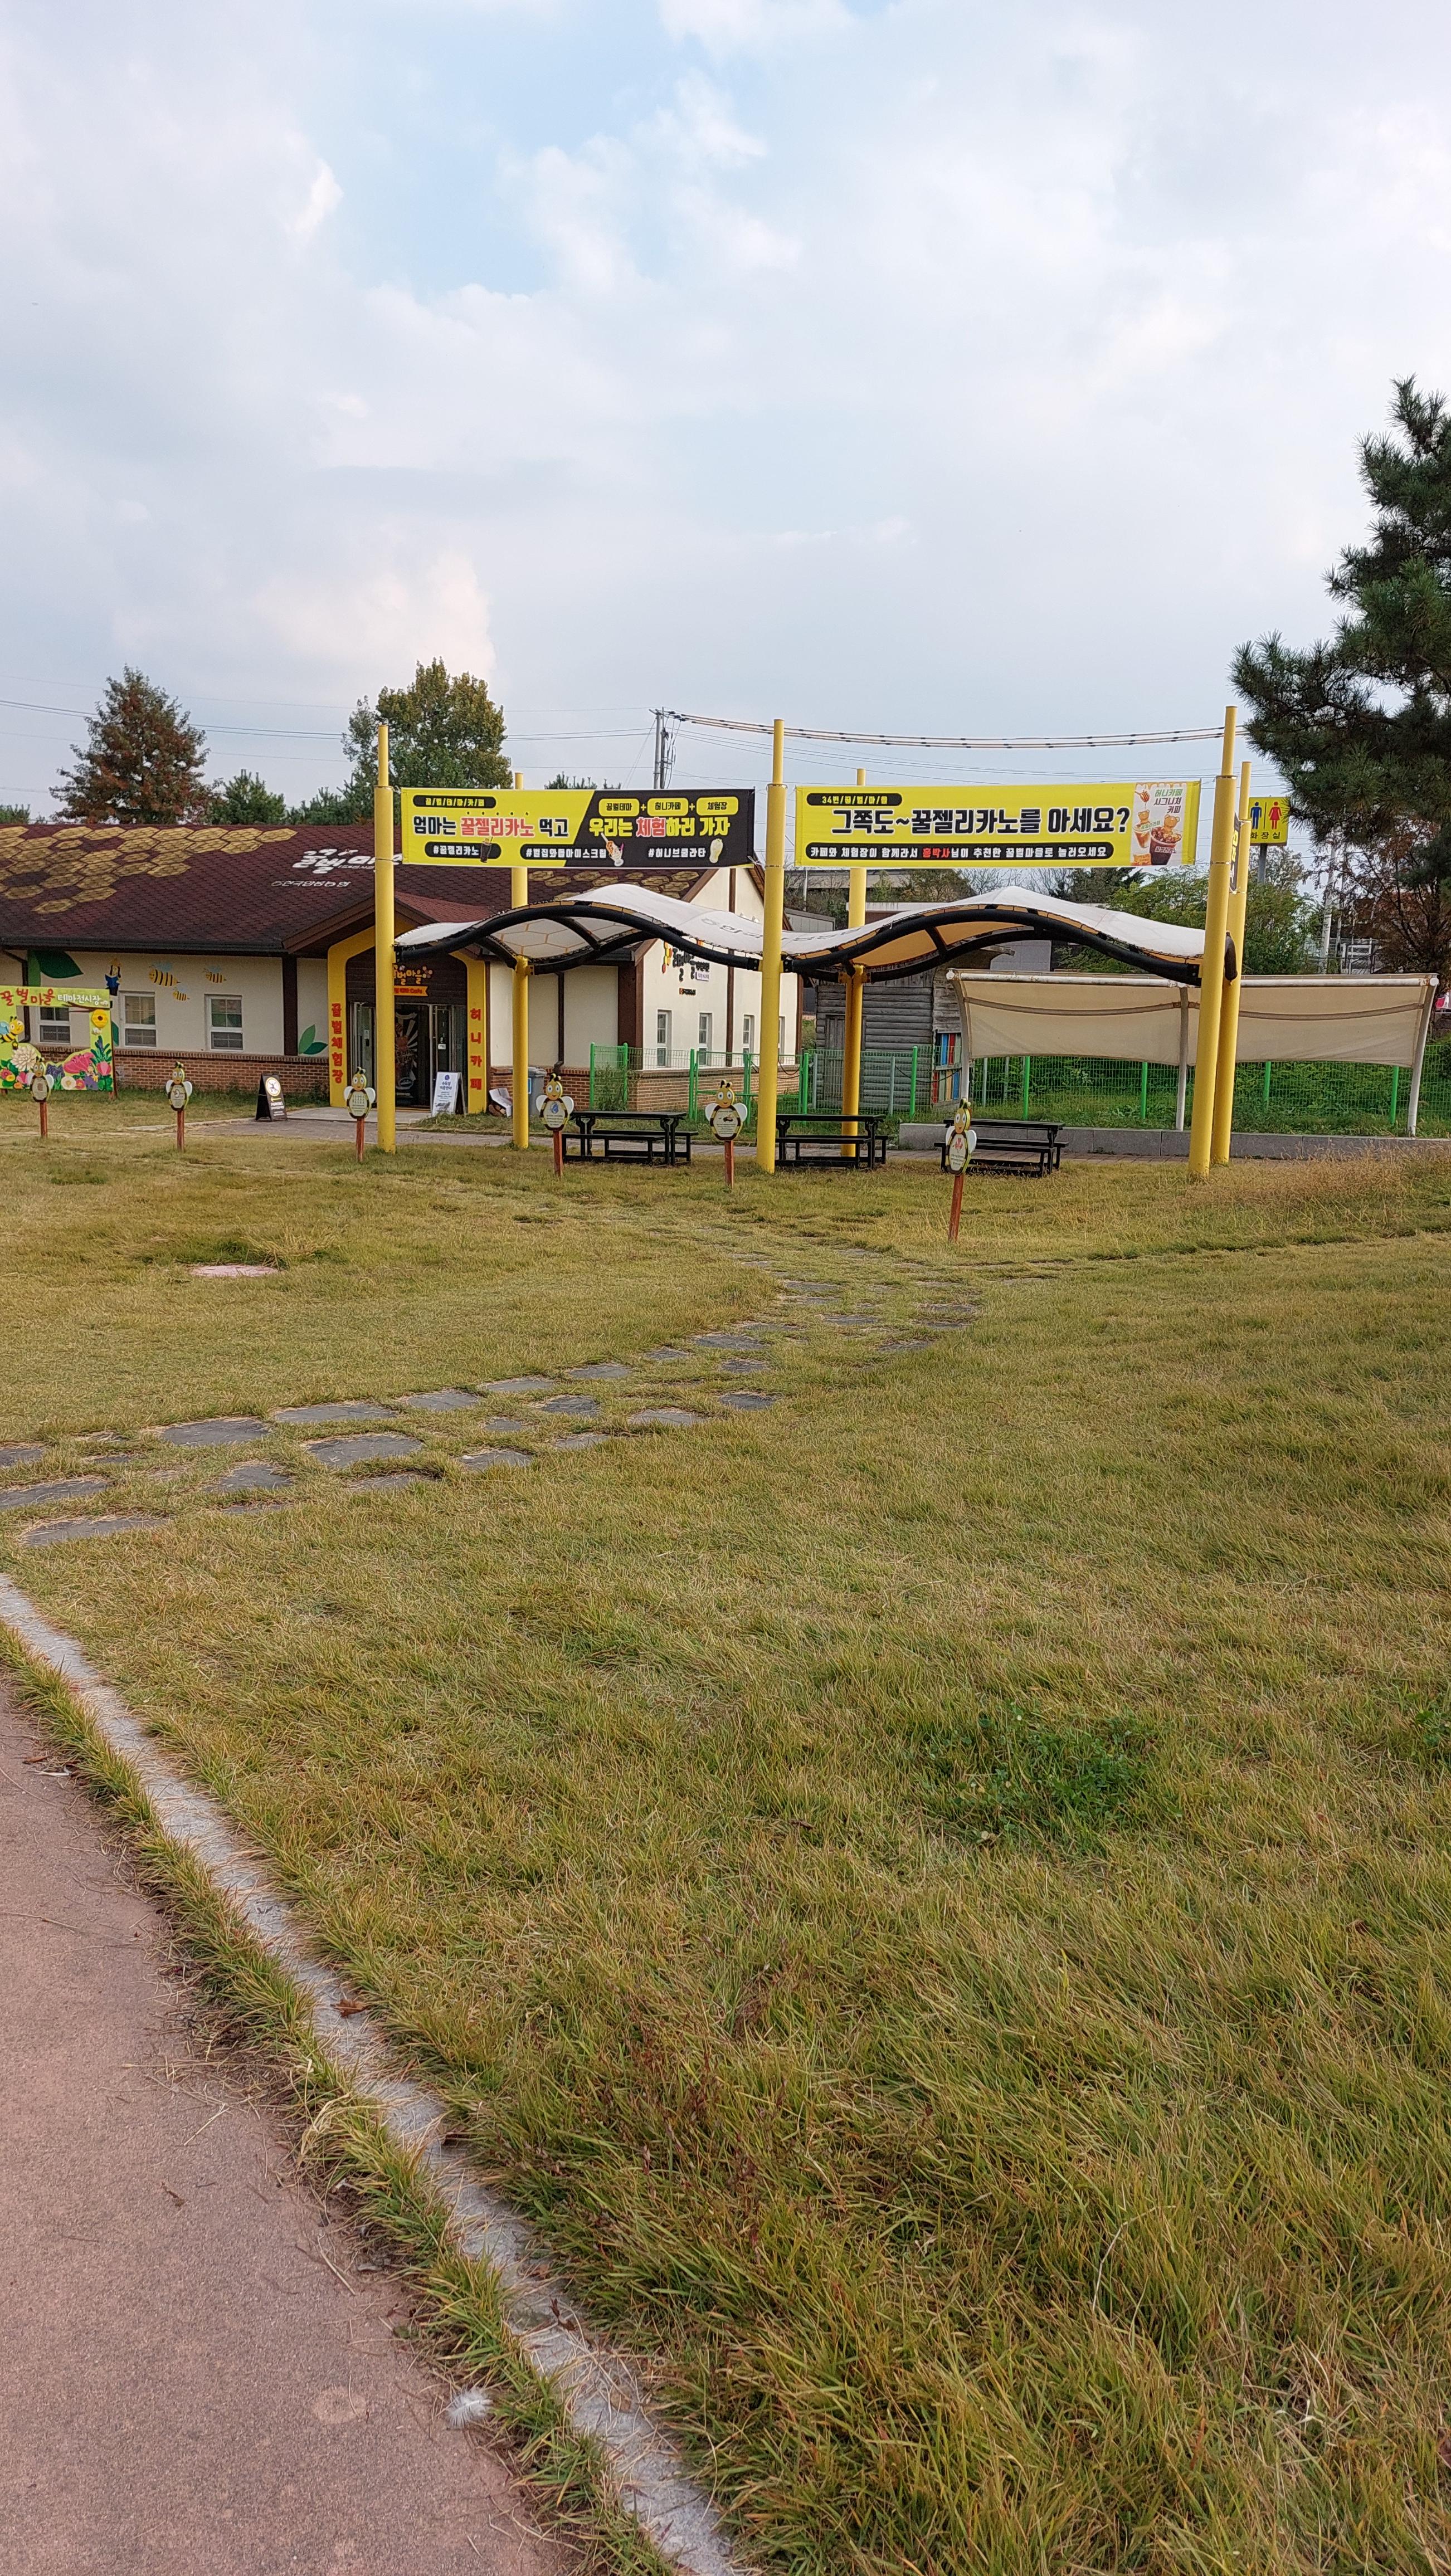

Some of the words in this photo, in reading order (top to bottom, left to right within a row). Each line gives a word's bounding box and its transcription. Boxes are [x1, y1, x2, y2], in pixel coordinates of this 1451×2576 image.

[1155, 788, 1183, 797] 허니카페
[655, 802, 681, 811] 허니카페
[707, 802, 727, 811] 체험장
[1153, 797, 1182, 806] 시그니쳐
[1167, 806, 1181, 814] 커피
[831, 809, 1041, 834] 그쪽도~꿀젤리카노를
[1048, 807, 1130, 833] 아세요?
[413, 816, 456, 836] 엄마는
[461, 817, 534, 837] 꿀젤리카노
[539, 818, 568, 837] 먹고
[589, 817, 633, 837] 우리는
[636, 817, 695, 837] 체험하러
[700, 817, 730, 836] 가자
[433, 845, 479, 856] #꿀젤리카노
[648, 847, 706, 858] #허니브쿨라타
[811, 847, 838, 857] 카페와
[841, 847, 877, 858] 체험장이
[882, 847, 918, 858] 함께라서
[922, 847, 968, 858] 홍박사님이
[973, 847, 1002, 858] 추천한
[1006, 847, 1053, 858] 꿀벌마을로
[1058, 846, 1107, 857] 놀러오세요
[0, 988, 56, 1006] 꿀벌마을
[57, 993, 101, 1006] 테마전시장
[331, 1003, 344, 1084] 꿀벌체험장
[470, 1008, 483, 1090] 허니카페
